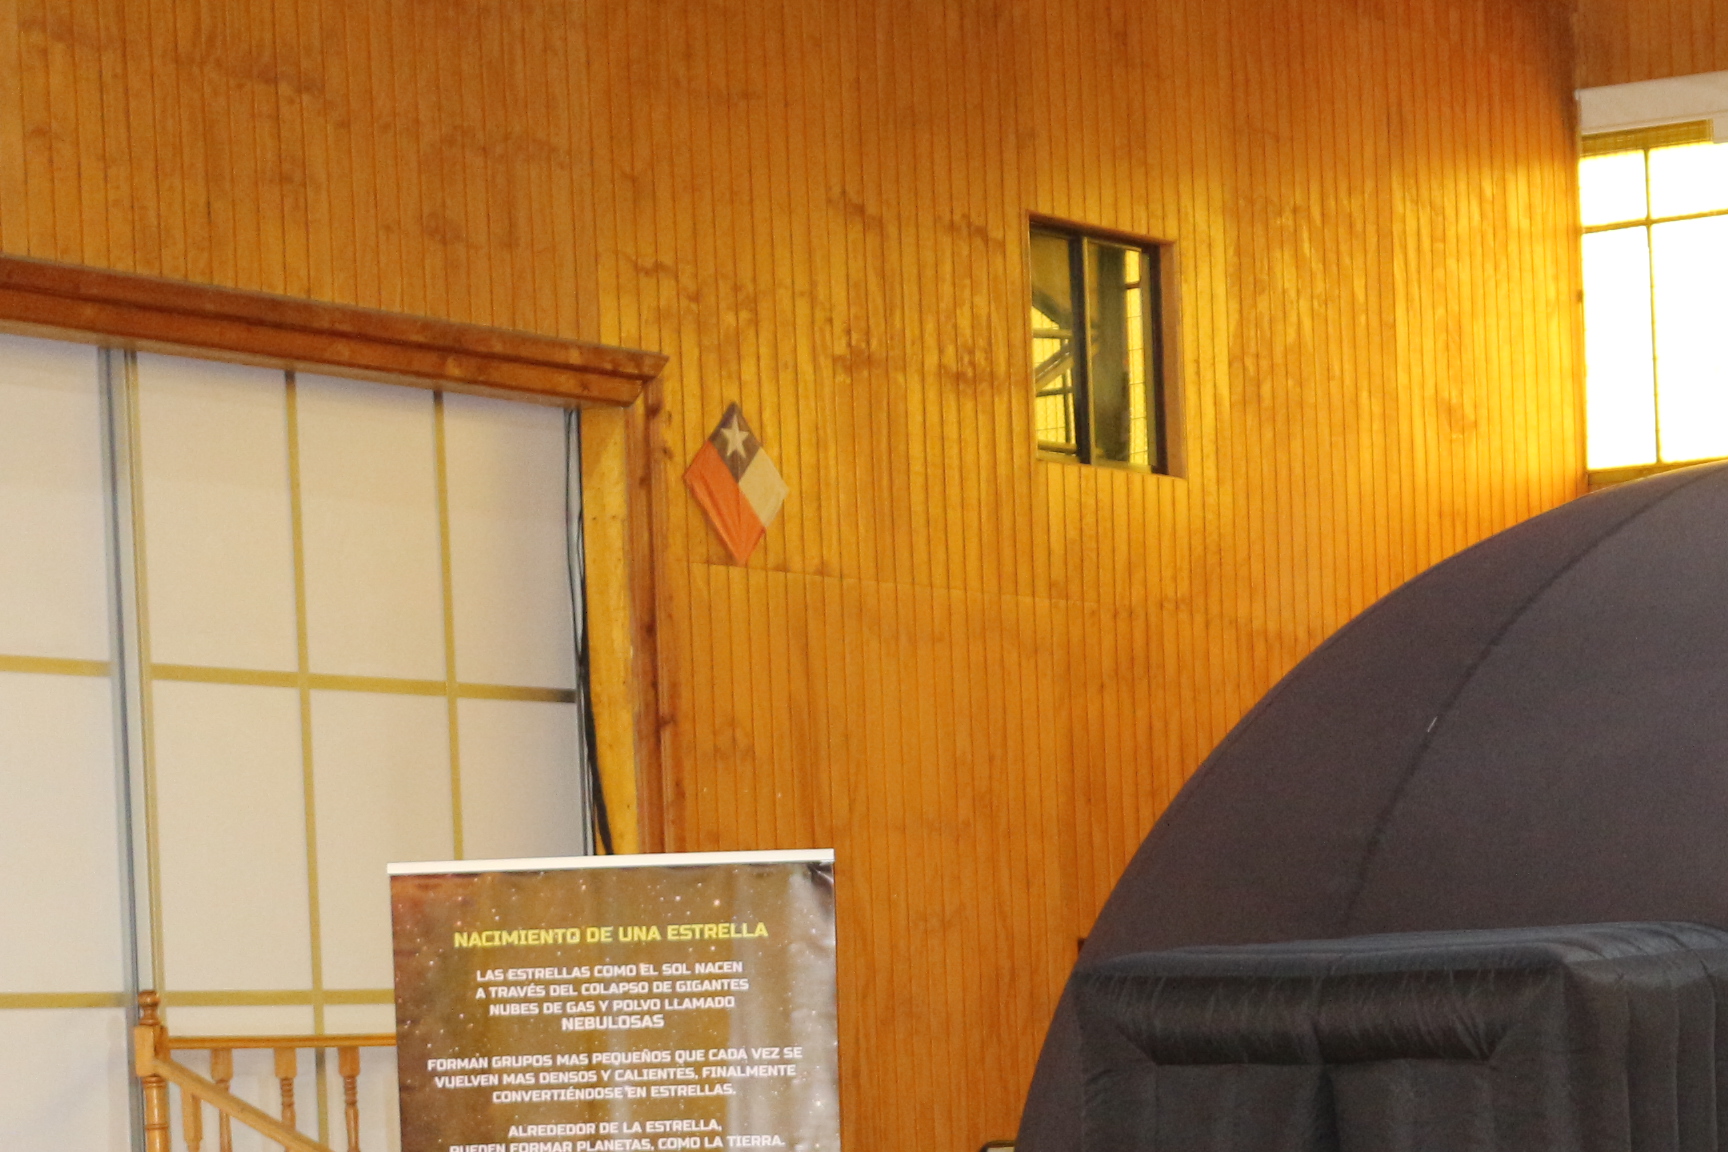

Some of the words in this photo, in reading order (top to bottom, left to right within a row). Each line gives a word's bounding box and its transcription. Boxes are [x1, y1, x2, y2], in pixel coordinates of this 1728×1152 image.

[454, 928, 580, 949] NACIMIENTO
[586, 926, 612, 943] DE
[618, 925, 661, 942] UNA
[667, 921, 768, 940] ESTRELLA
[476, 969, 504, 982] LAS
[508, 966, 590, 980] ESTRELLAS
[594, 964, 636, 977] COMO
[641, 964, 658, 976] EL
[662, 963, 691, 975] SOL
[695, 961, 743, 974] NACEN
[476, 987, 486, 999] A
[489, 983, 546, 998] TRAVÉS
[550, 984, 578, 996] DEL
[581, 981, 649, 995] COLAPSO
[652, 981, 672, 993] DE
[675, 978, 749, 992] GIGANTES
[489, 1003, 539, 1016] NUBES
[543, 1002, 562, 1014] DE
[566, 1001, 595, 1013] GAS
[599, 1000, 610, 1012] Y
[613, 998, 661, 1012] POLVO
[665, 996, 735, 1010] LLAMADO
[561, 1014, 665, 1031] NEBULOSAS
[427, 1057, 488, 1071] FORMAN
[491, 1055, 552, 1068] GRUPOS
[556, 1053, 589, 1066] MAS
[591, 1049, 671, 1066] PEQUEÑOS
[675, 1049, 705, 1063] QUE
[708, 1048, 748, 1061] CADA
[751, 1047, 780, 1059] VEZ
[783, 1046, 803, 1059] SE
[435, 1073, 499, 1089] VUELVEN
[502, 1072, 535, 1085] MAS
[539, 1070, 598, 1084] DENSOS
[601, 1069, 612, 1082] Y
[702, 1064, 796, 1078] FINALMENTE
[492, 1086, 623, 1103] CONVERTIÉNDOSE
[627, 1085, 647, 1098] EN
[651, 1083, 736, 1097] ESTRELLAS.
[508, 1123, 596, 1138] ALREDEDOR
[600, 1122, 618, 1135] DE
[622, 1121, 642, 1133] LA
[658, 1138, 701, 1150] COMO
[704, 1136, 723, 1149] LA
